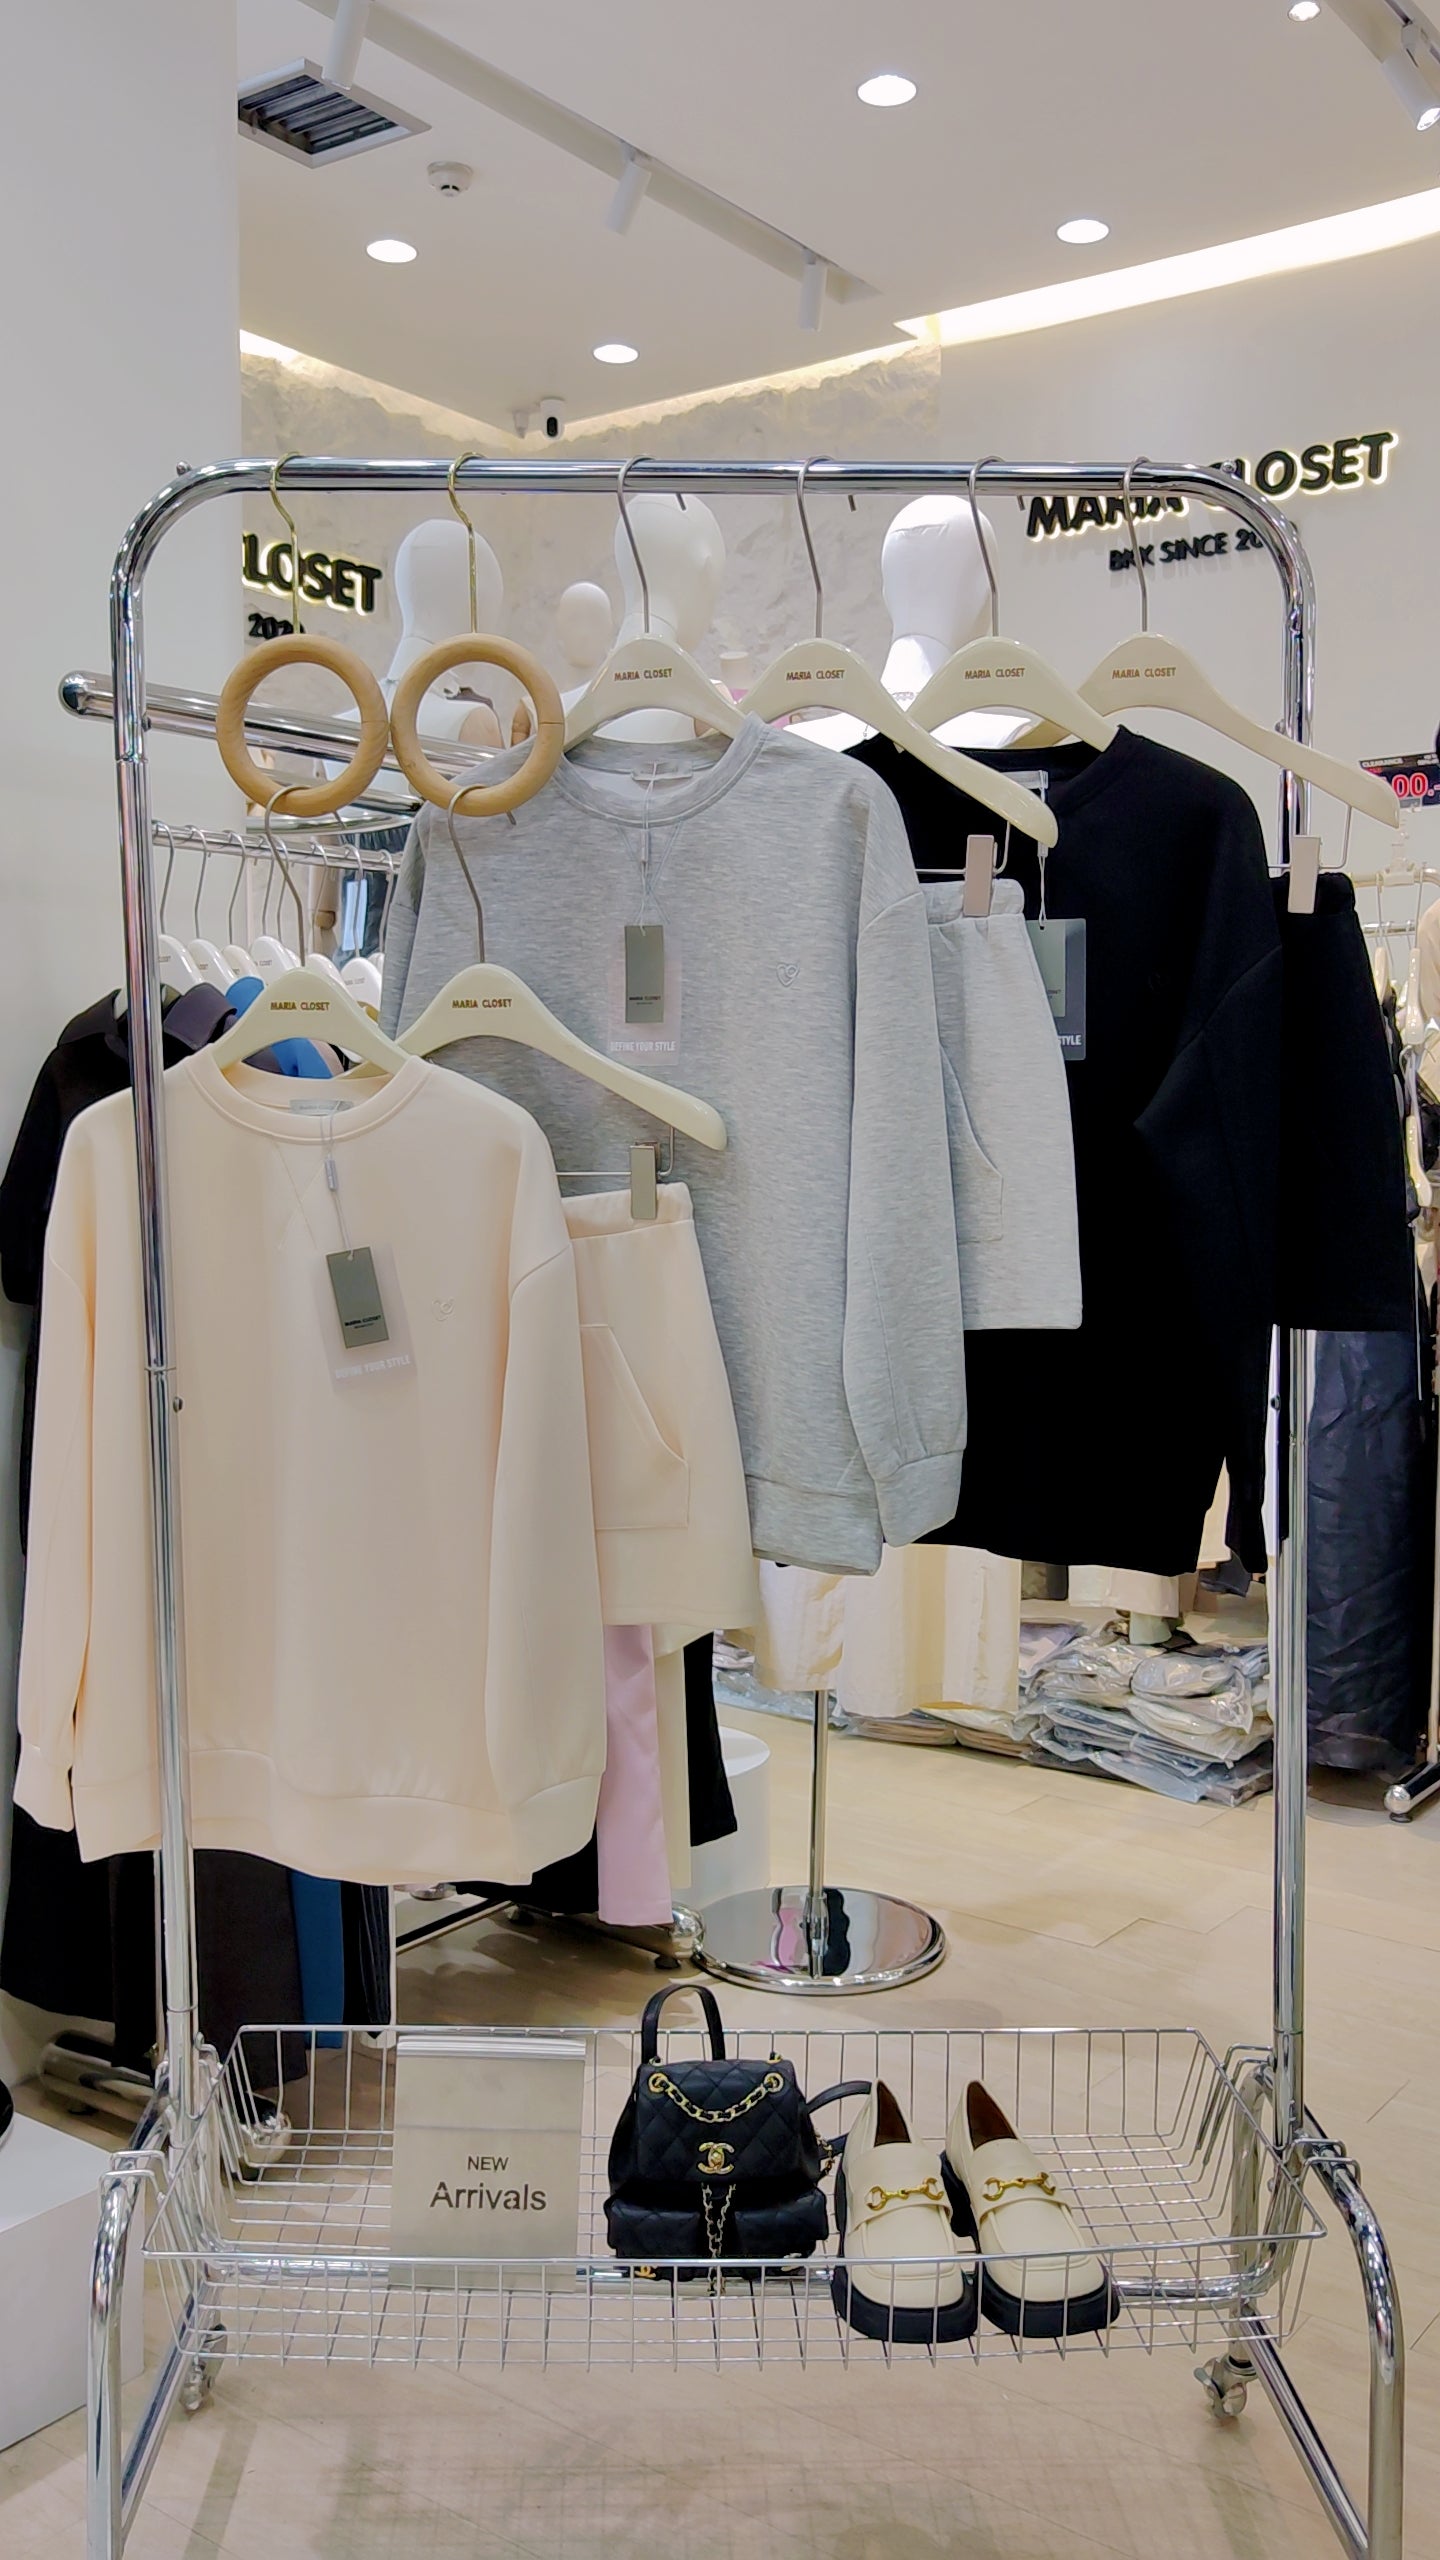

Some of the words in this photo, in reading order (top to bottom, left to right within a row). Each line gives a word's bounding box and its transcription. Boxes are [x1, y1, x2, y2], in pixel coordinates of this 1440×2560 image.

[1208, 431, 1394, 497] OSET
[1159, 532, 1228, 563] SINCE
[243, 533, 383, 613] LOSET
[248, 612, 306, 640] 202
[614, 670, 640, 682] MARIA
[643, 668, 673, 680] CLOSET
[786, 670, 812, 682] MARIA
[815, 669, 845, 681] CLOSET
[964, 669, 991, 680] MARIA
[995, 667, 1025, 679] CLOSET
[1112, 668, 1140, 680] MARIA
[1144, 667, 1177, 679] CLOSET
[270, 1001, 297, 1011] MARIA
[300, 1001, 330, 1011] CLOSET
[452, 998, 478, 1009] MARIA
[482, 998, 512, 1009] CLOSET
[655, 1040, 676, 1052] STYLE
[467, 2155, 509, 2172] NEW
[430, 2181, 547, 2211] Arrivals
